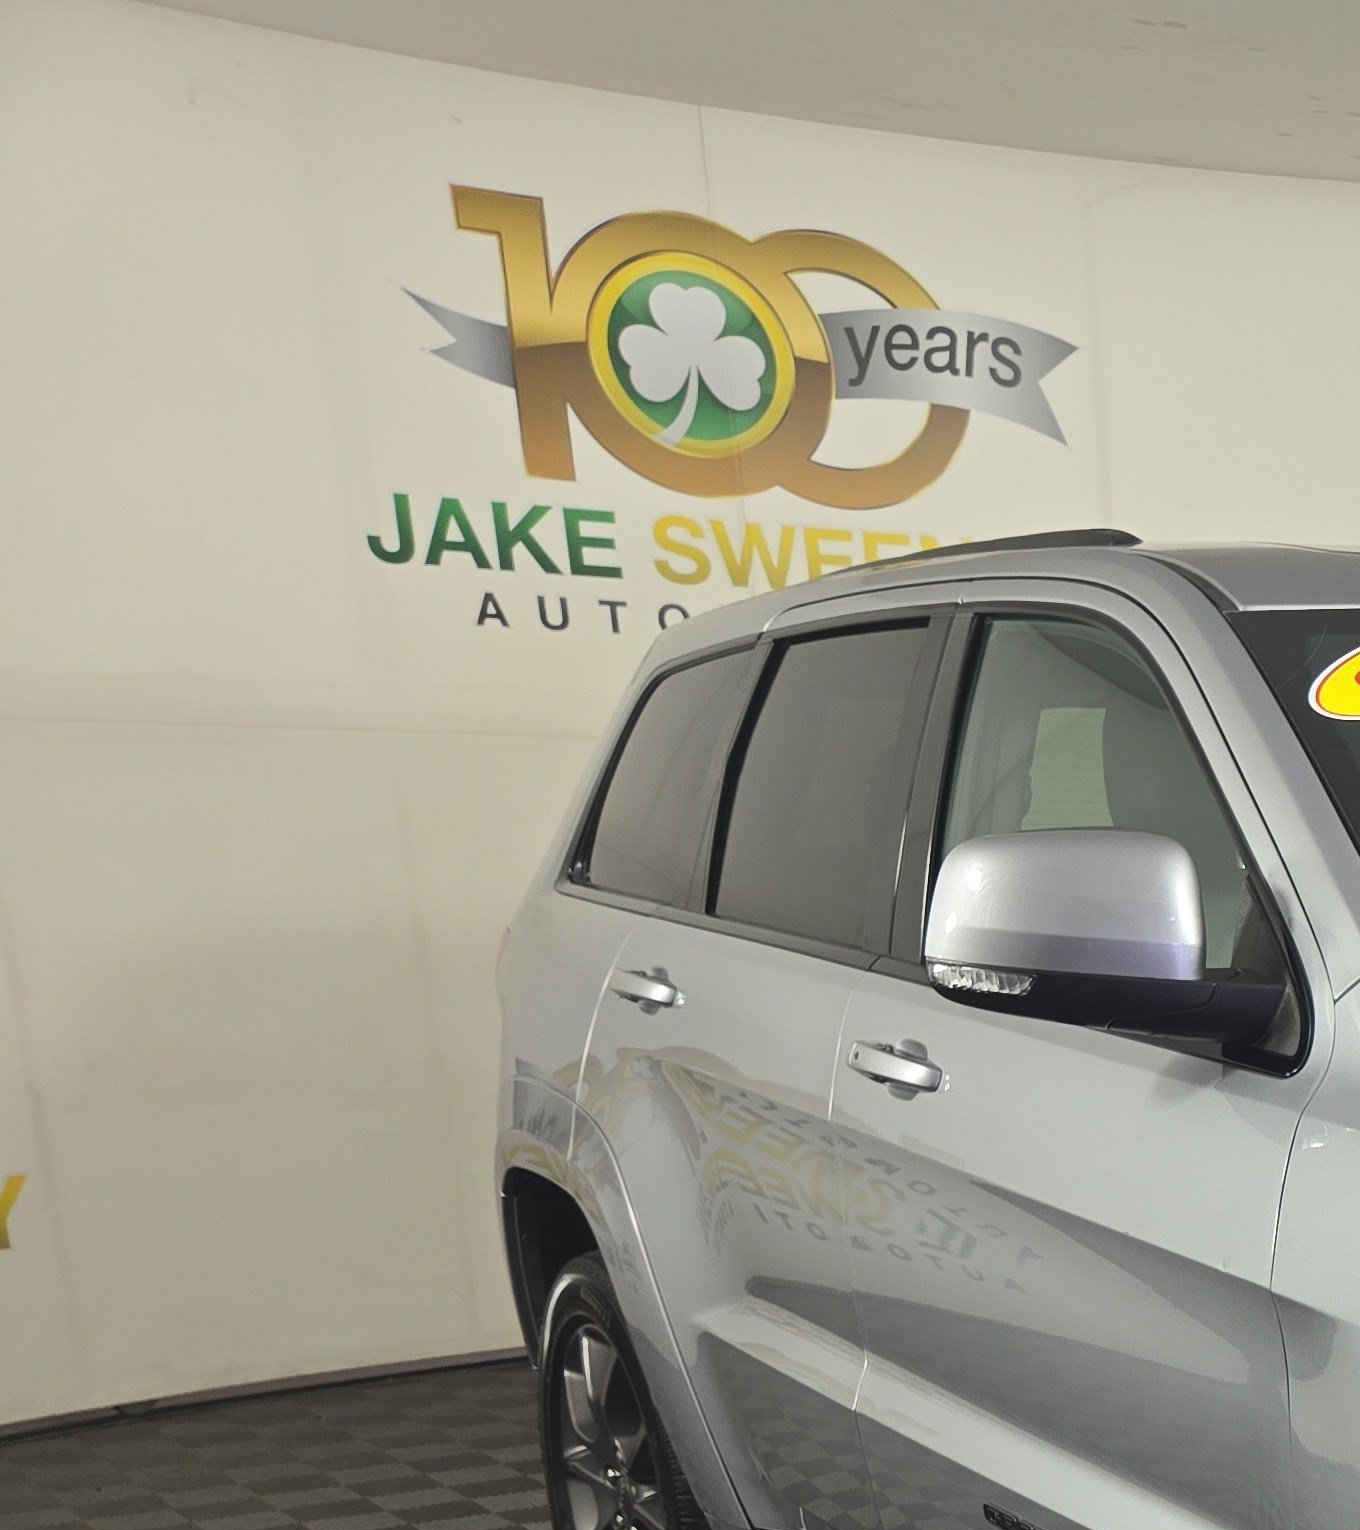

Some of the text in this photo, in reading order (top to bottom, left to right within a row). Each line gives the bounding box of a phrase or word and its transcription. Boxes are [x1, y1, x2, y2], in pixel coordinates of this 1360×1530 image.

[450, 182, 970, 511] 100
[846, 323, 1026, 391] years
[366, 493, 625, 579] JAKE
